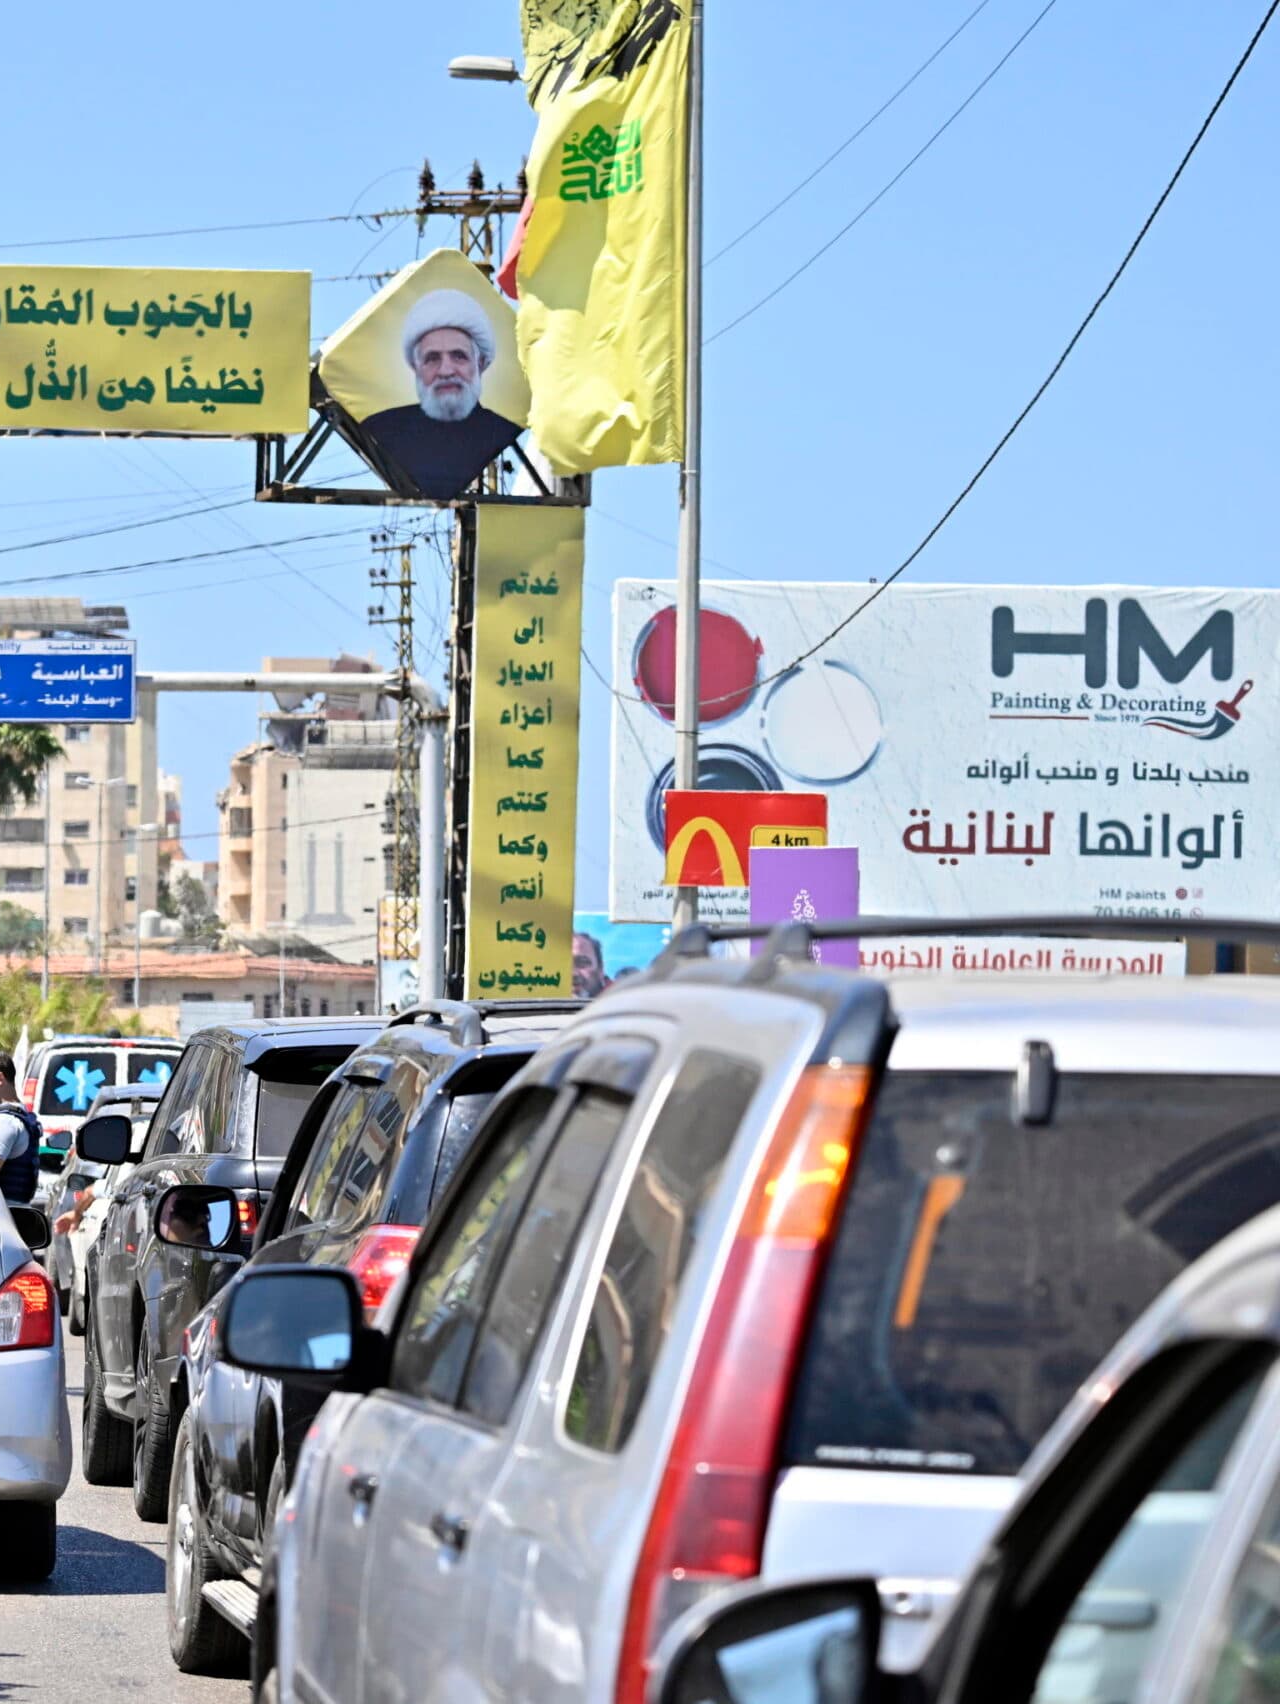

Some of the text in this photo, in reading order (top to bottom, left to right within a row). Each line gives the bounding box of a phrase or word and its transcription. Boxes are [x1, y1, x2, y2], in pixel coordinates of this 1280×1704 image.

[514, 617, 544, 644] إلى
[991, 597, 1234, 688] HM
[31, 662, 124, 686] العباسية
[496, 660, 553, 687] الديار
[500, 698, 552, 731] أعزاء
[990, 691, 1207, 715] Painting & Decorating
[506, 747, 545, 769] كما
[967, 752, 1250, 787] منحب بلدنا و منحب ألوانه
[496, 791, 548, 816] كنتم
[498, 834, 548, 862] وكما
[771, 834, 809, 846] 4 km
[902, 808, 1244, 869] ألوانها لبنانية
[500, 872, 544, 904] أنتم
[1100, 888, 1166, 901] HM paints
[496, 920, 546, 949] وكما
[478, 963, 561, 992] ستبقون
